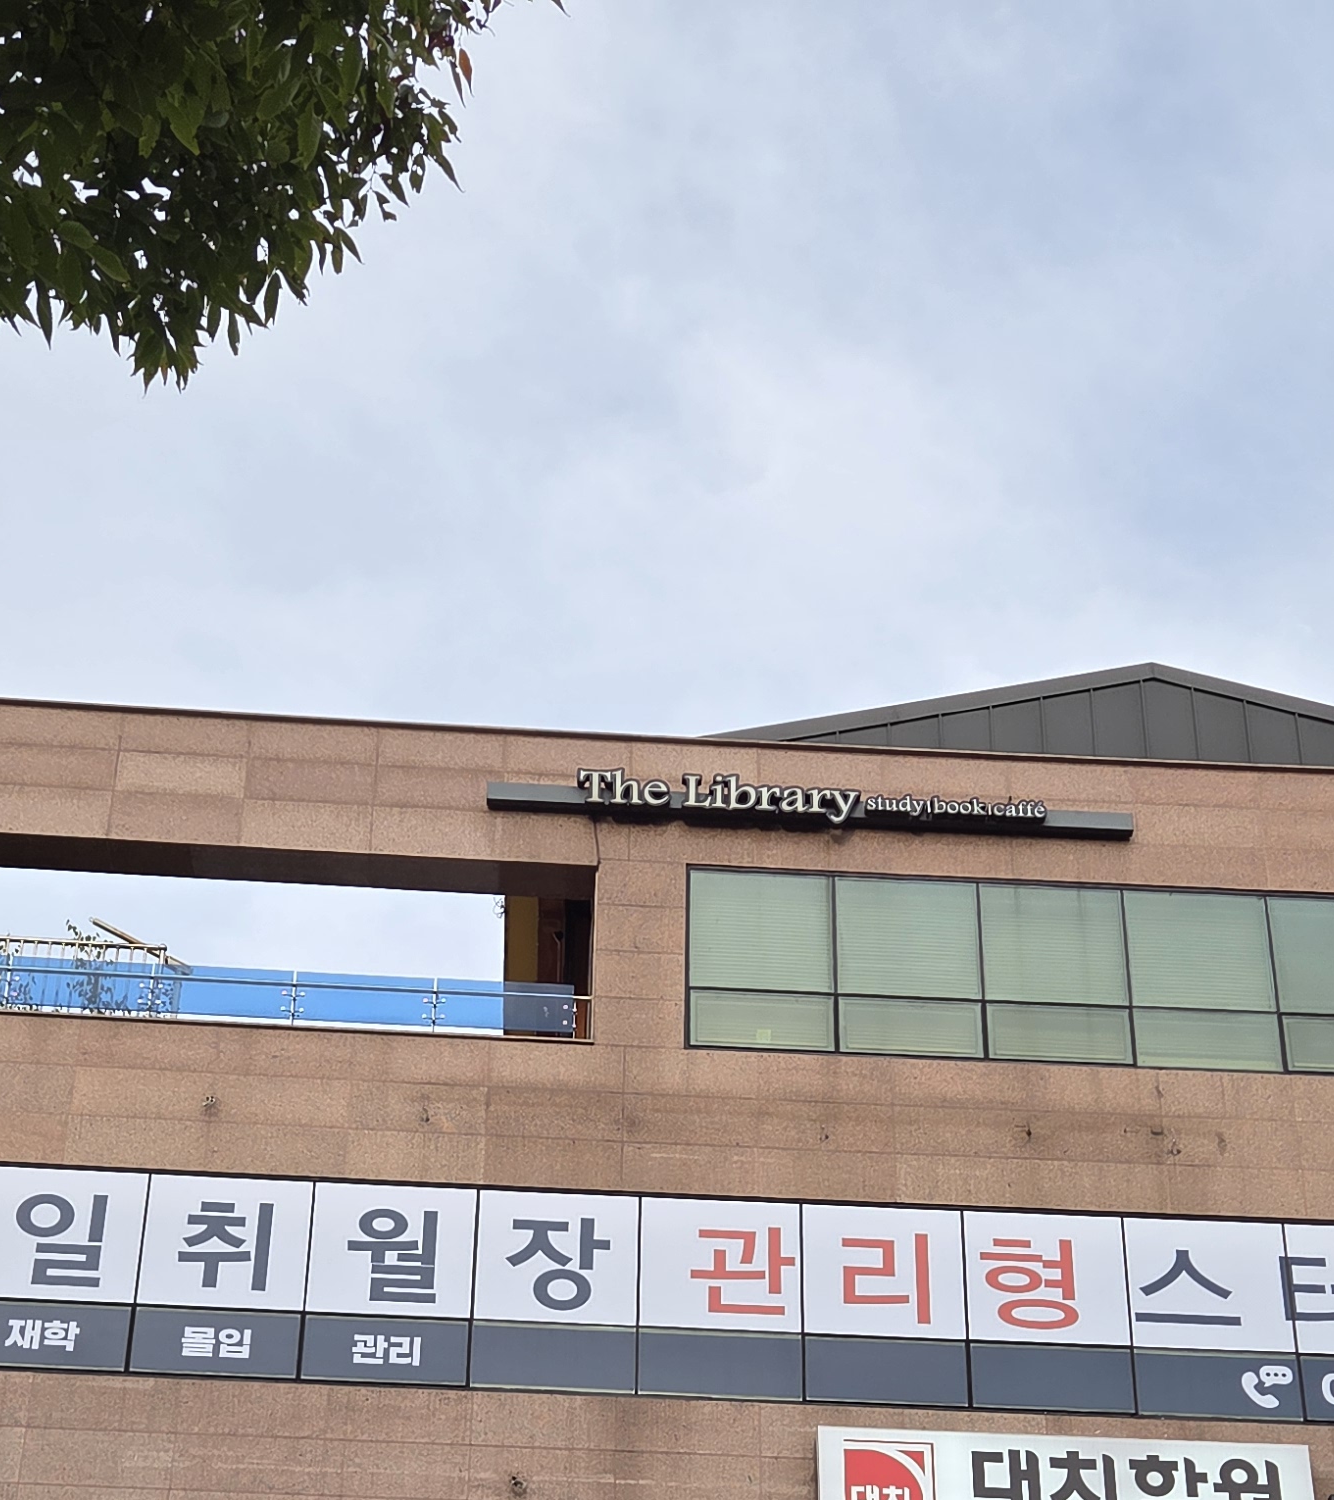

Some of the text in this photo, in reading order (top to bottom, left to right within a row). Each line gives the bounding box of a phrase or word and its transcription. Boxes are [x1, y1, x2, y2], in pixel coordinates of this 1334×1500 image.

[578, 767, 860, 824] The Library
[690, 1226, 1080, 1330] 관리형
[4, 1317, 80, 1352] 재학
[180, 1325, 251, 1359] 몰입
[350, 1332, 421, 1367] 관리
